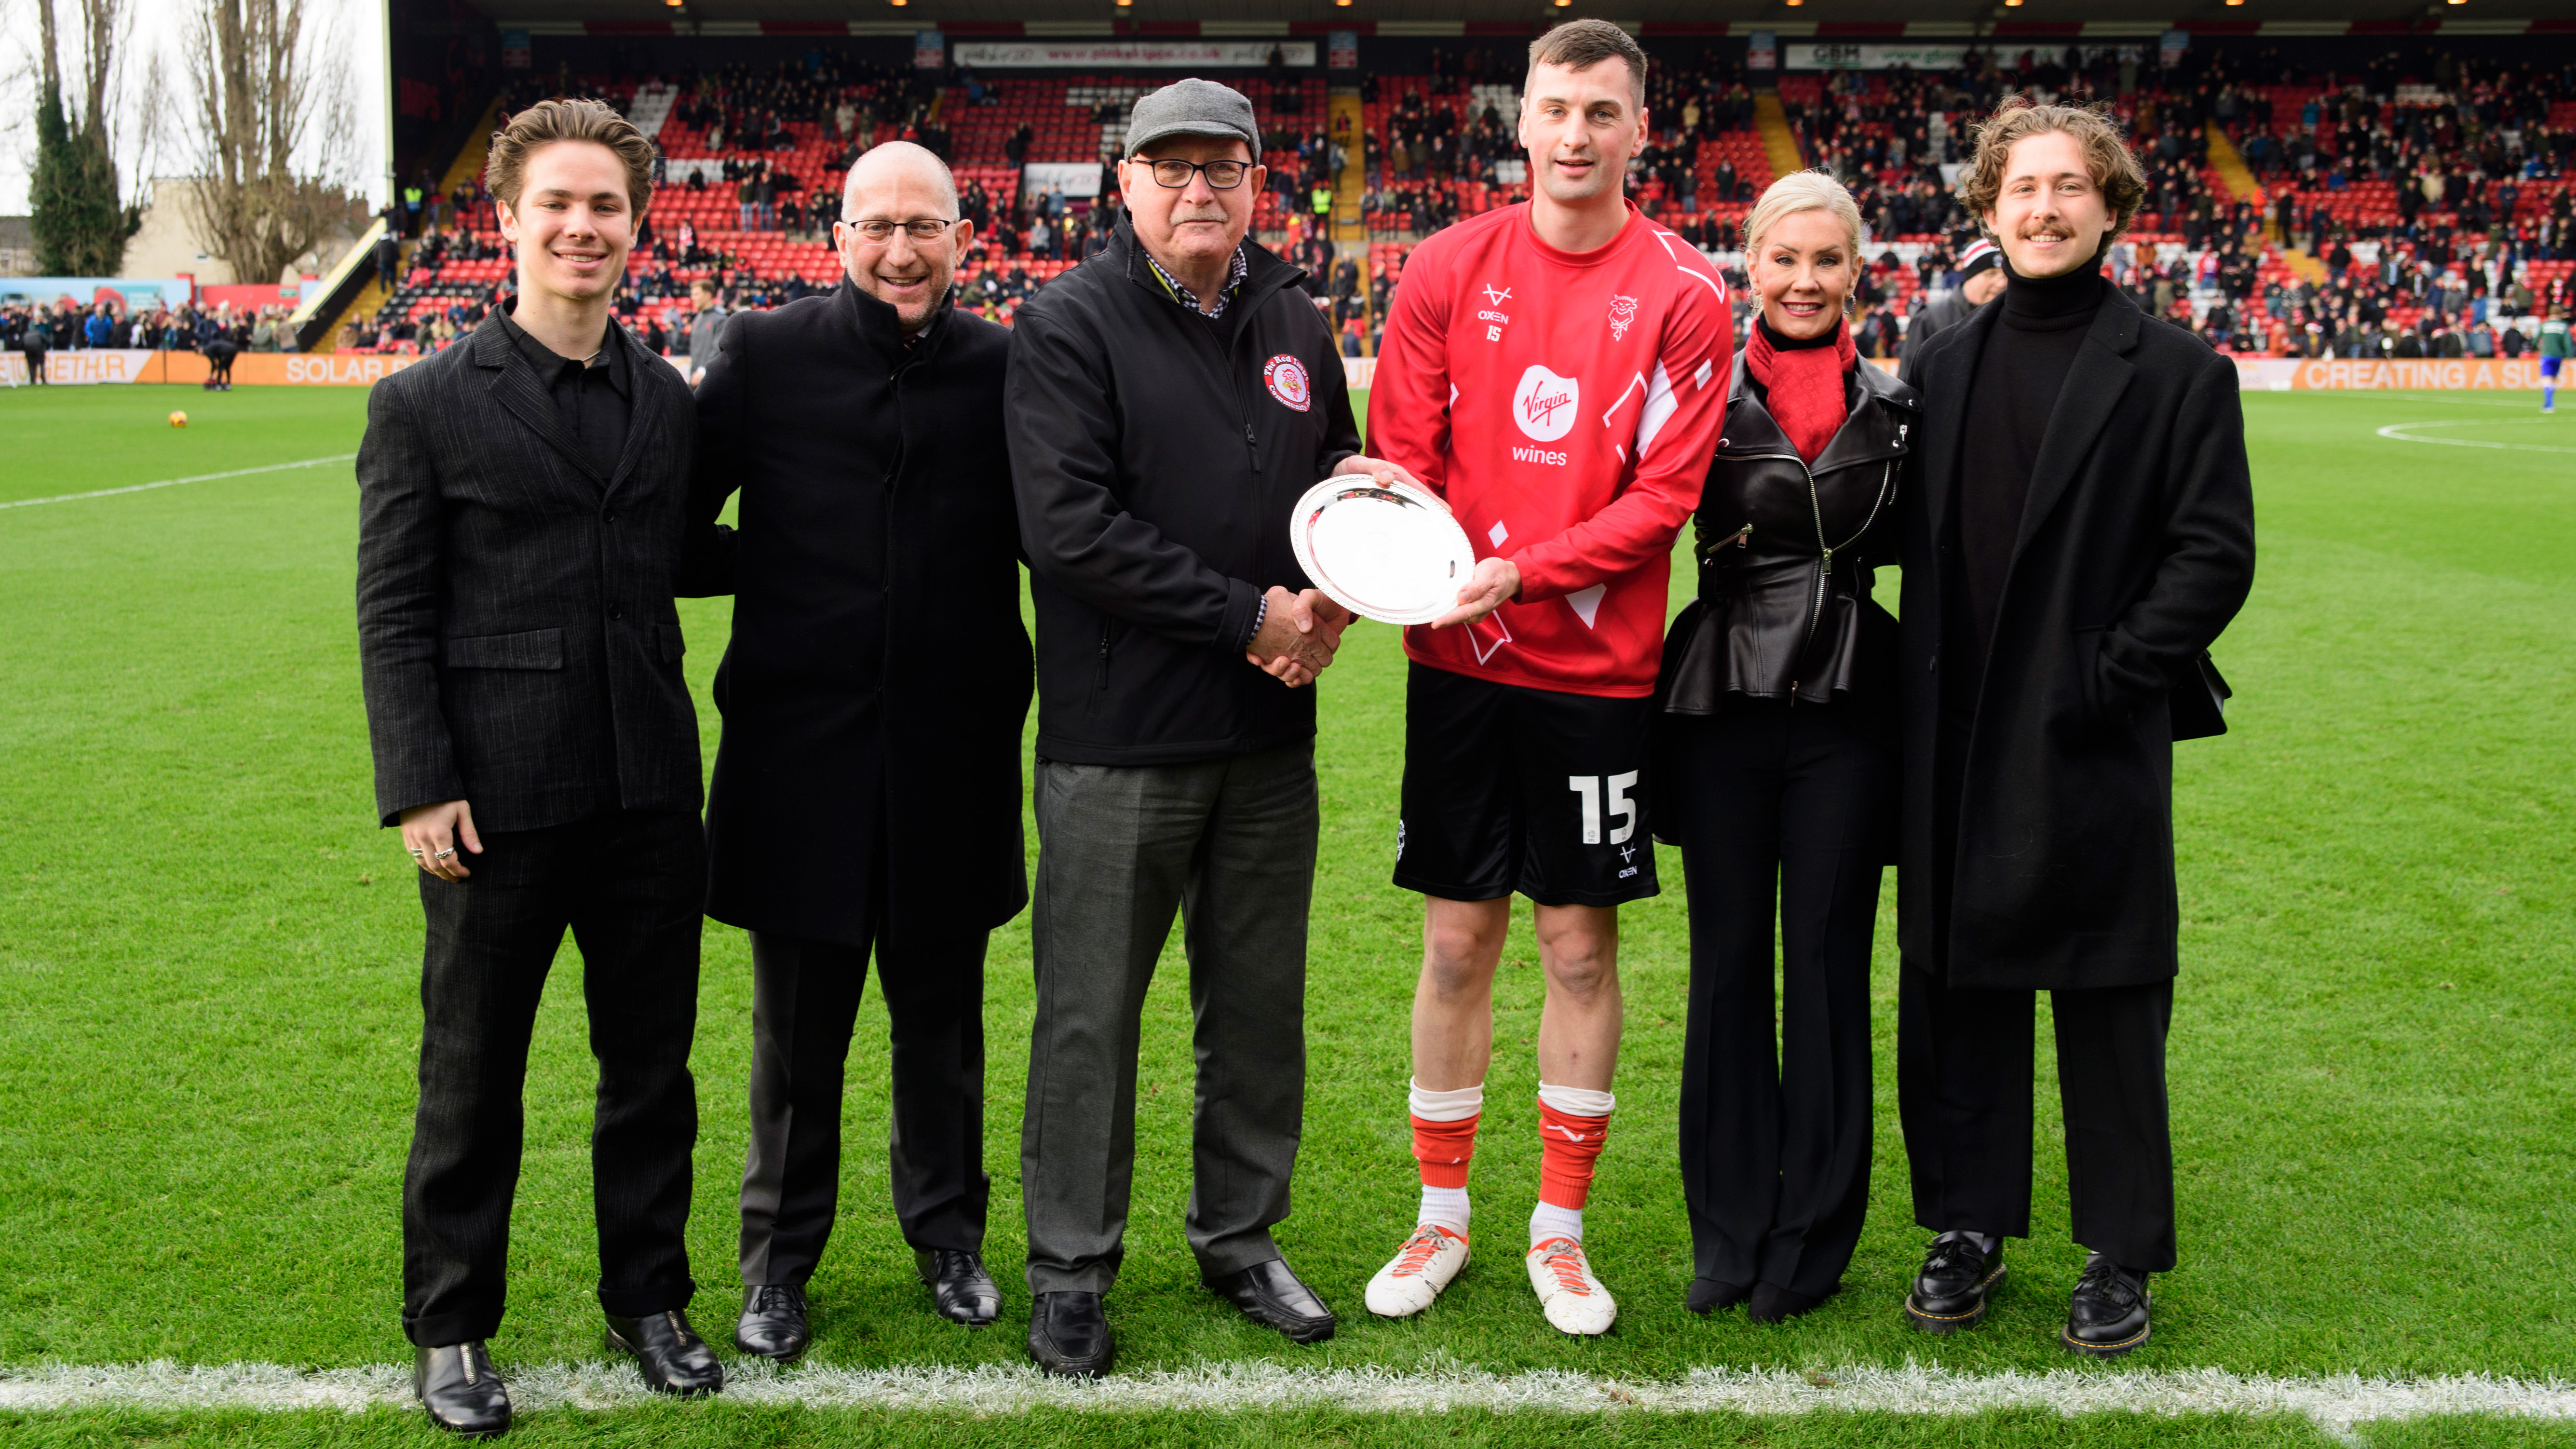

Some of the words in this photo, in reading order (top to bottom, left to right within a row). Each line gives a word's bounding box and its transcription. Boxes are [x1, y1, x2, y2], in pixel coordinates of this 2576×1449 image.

[1478, 311, 1509, 325] OXEN
[1486, 325, 1502, 342] 15
[286, 357, 383, 383] SOLAR
[1264, 361, 1276, 376] The
[1273, 355, 1292, 364] Red
[2305, 361, 2465, 389] CREATING
[2472, 363, 2495, 389] A
[1523, 380, 1572, 427] Virgin
[1512, 445, 1567, 466] wines
[1569, 770, 1639, 845] 15
[1618, 866, 1638, 879] OXEN
